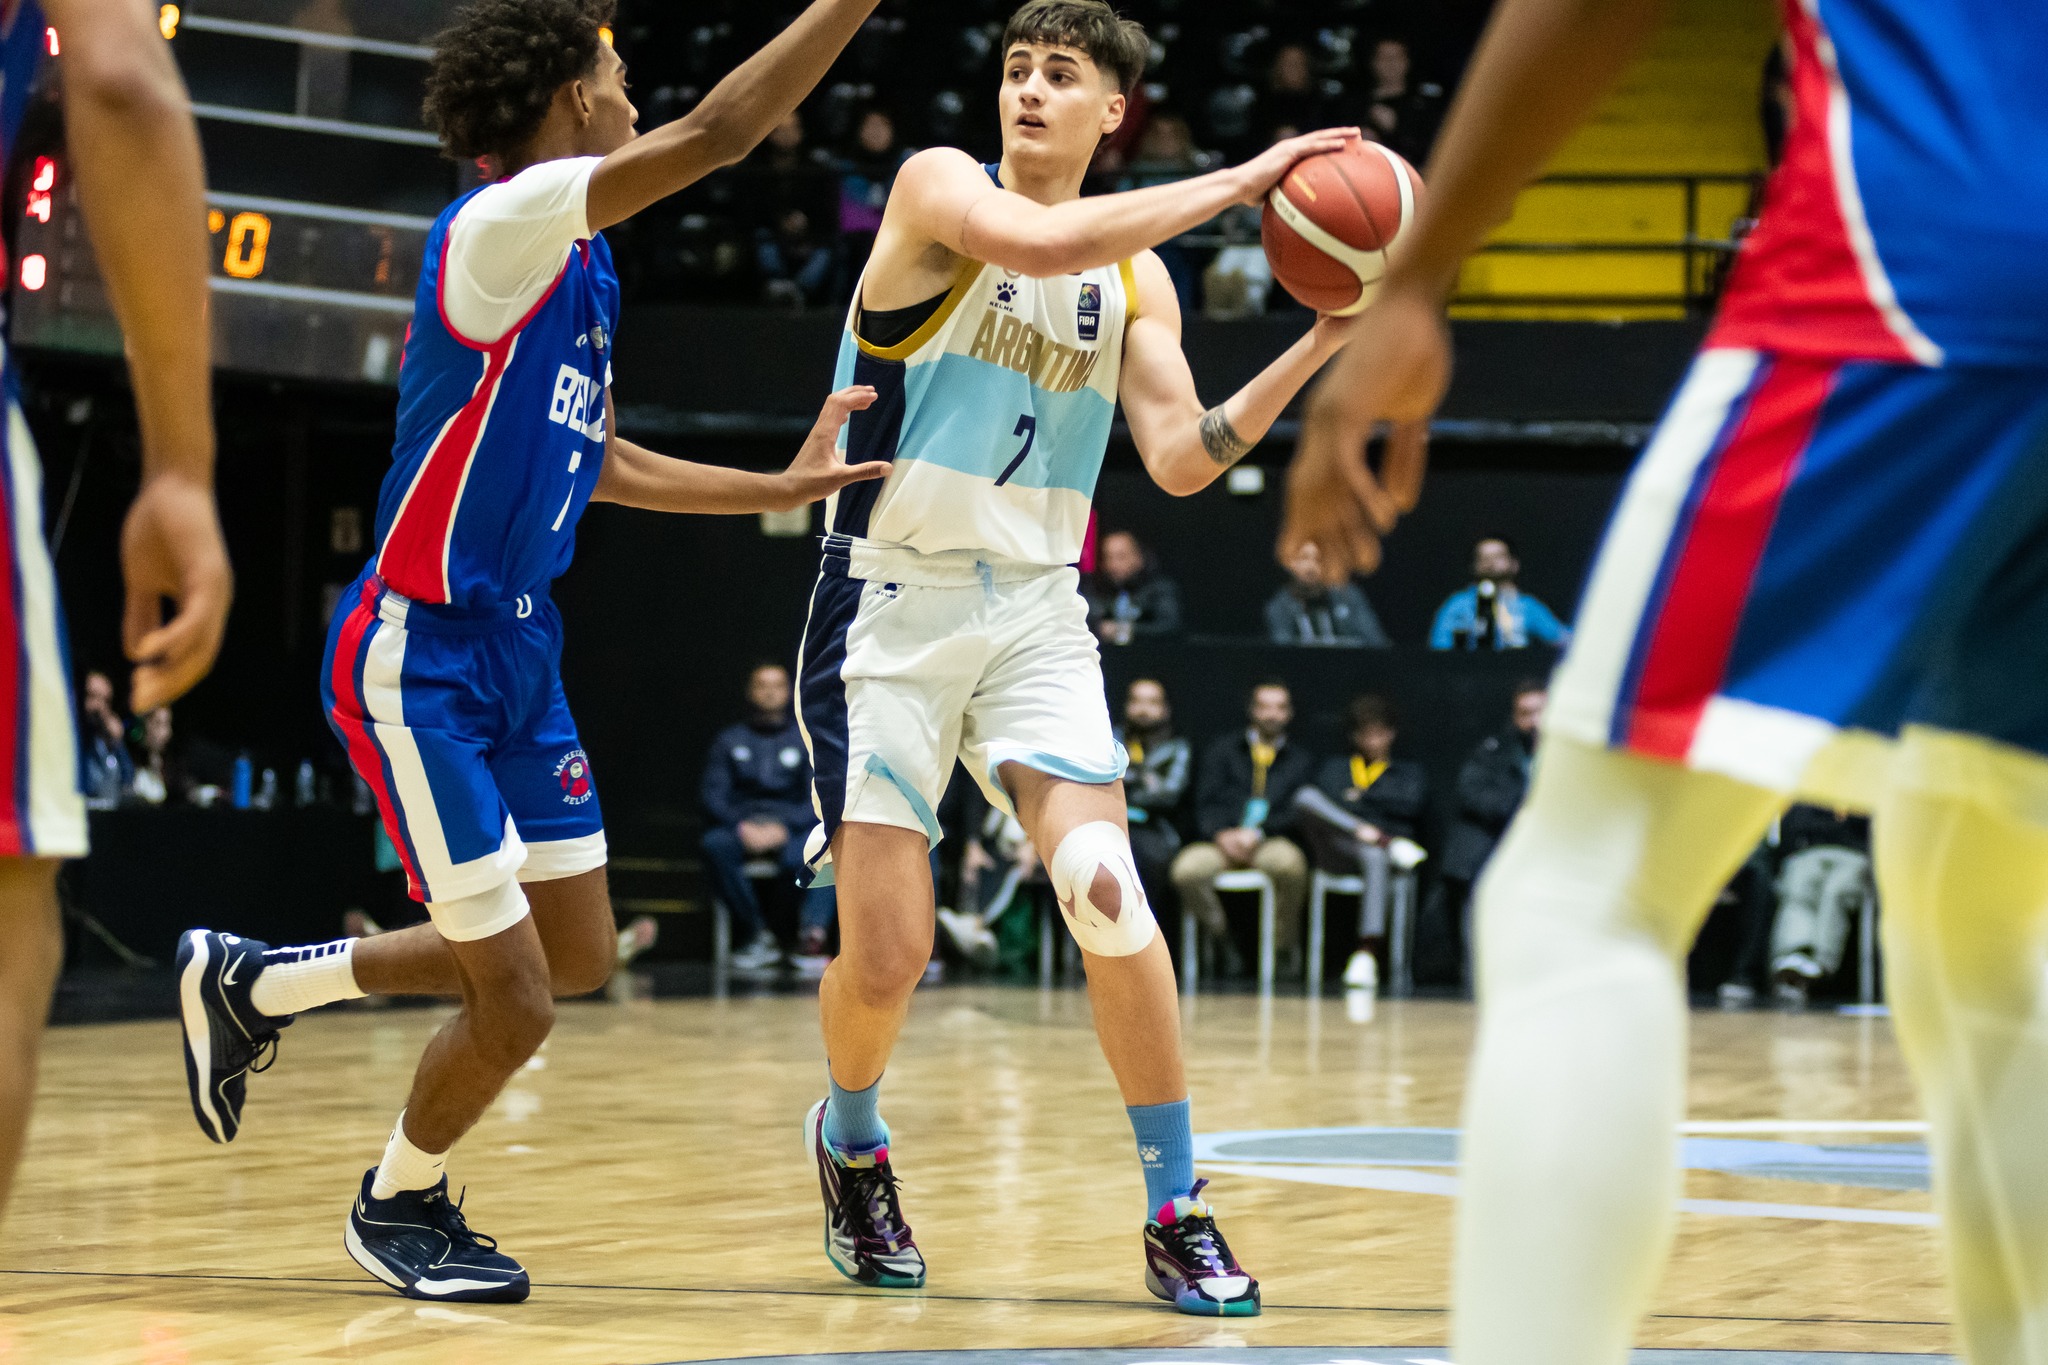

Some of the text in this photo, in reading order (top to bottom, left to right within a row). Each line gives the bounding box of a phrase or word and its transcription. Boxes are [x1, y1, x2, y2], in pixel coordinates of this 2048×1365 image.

[989, 301, 1014, 312] KELME
[1079, 315, 1096, 326] FIBA
[968, 309, 1102, 393] ARGNTINA
[993, 413, 1036, 486] 7
